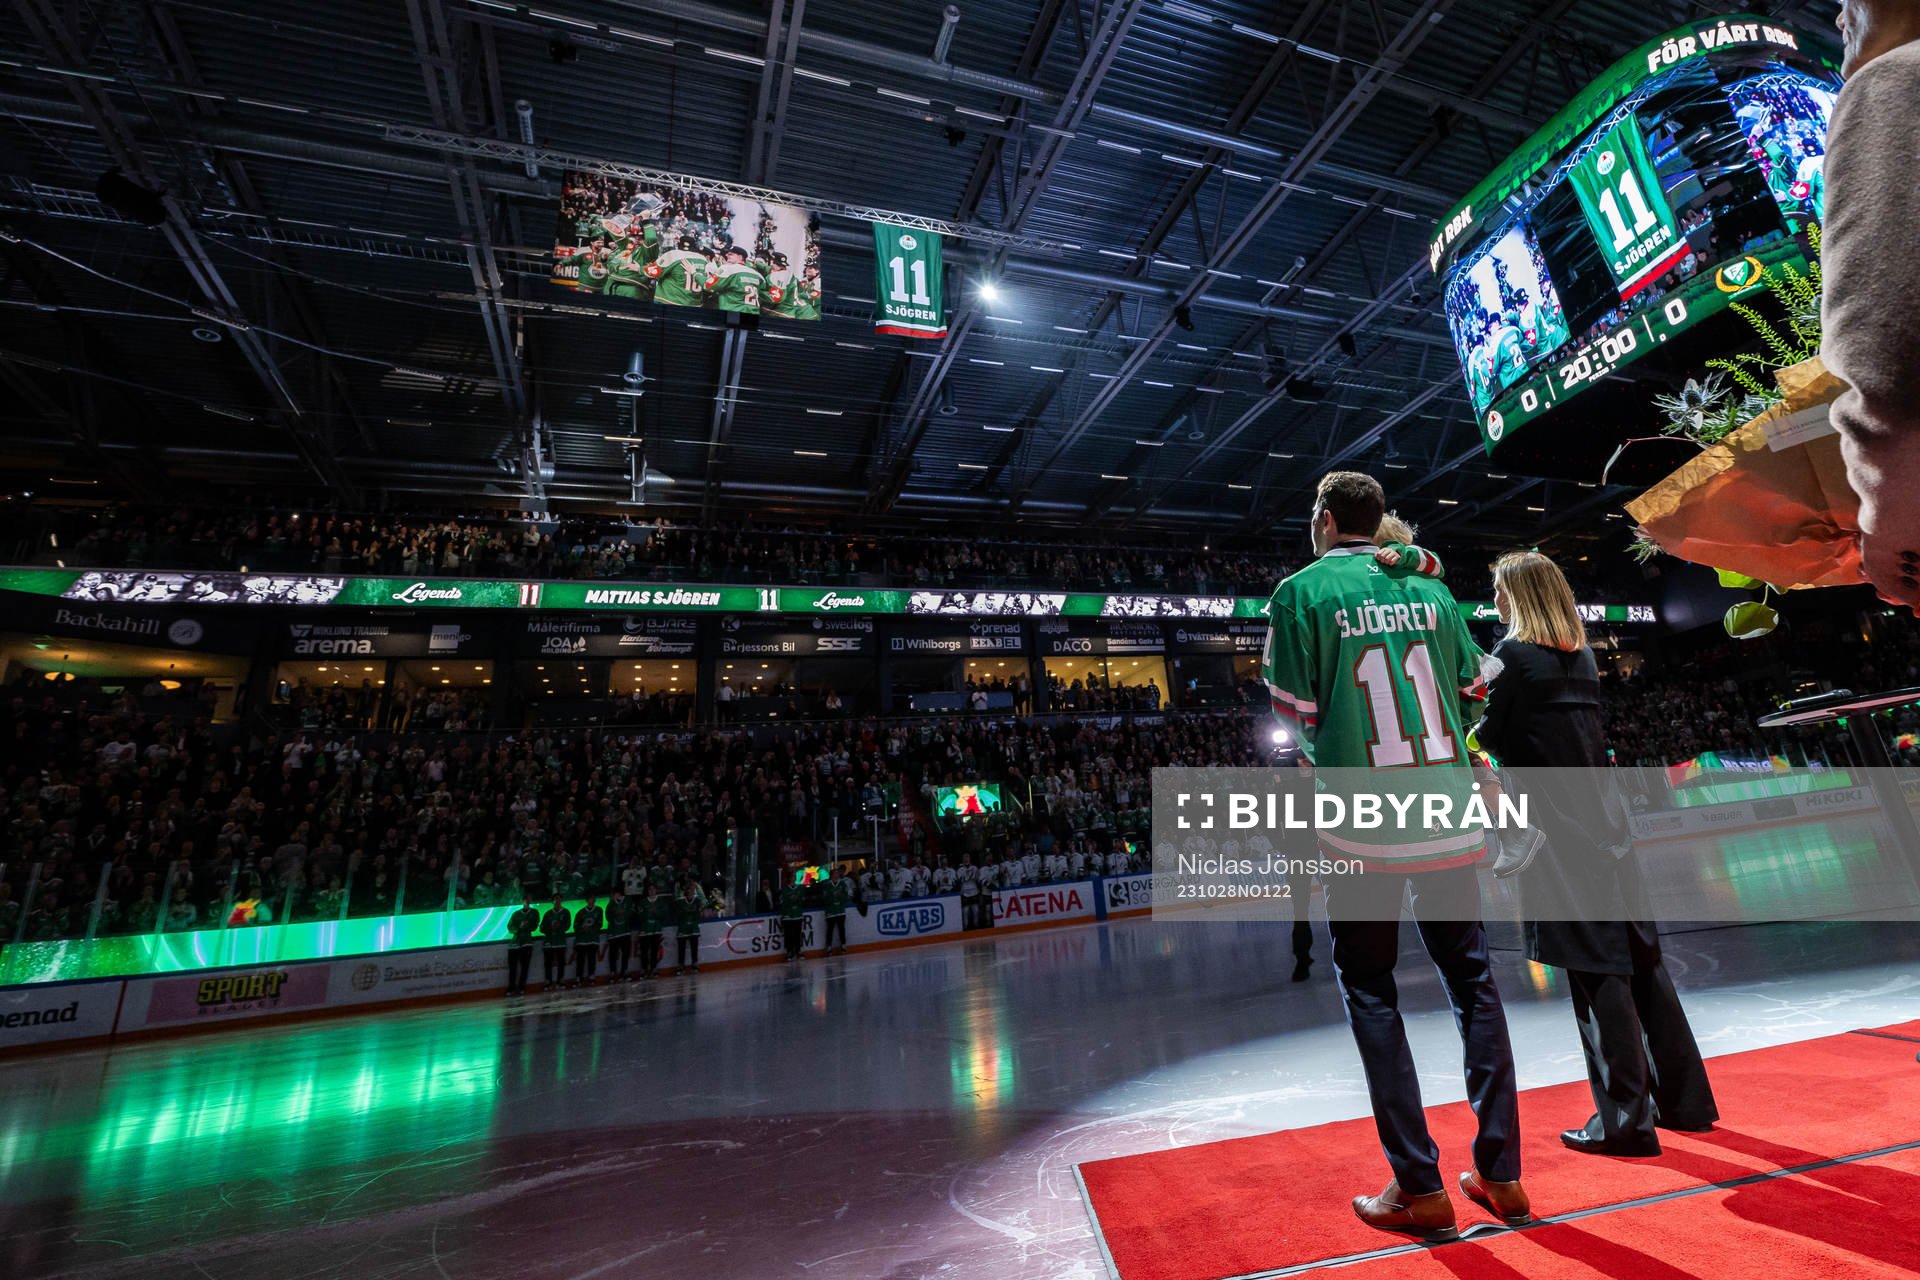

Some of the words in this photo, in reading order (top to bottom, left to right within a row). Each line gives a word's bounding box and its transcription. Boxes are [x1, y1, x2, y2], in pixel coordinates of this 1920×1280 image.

[1647, 37, 1697, 73] FÖR
[1699, 20, 1758, 49] VÅRT
[1598, 168, 1657, 253] 11
[1445, 204, 1473, 244] RBK
[1614, 224, 1672, 275] SJÖGREN
[889, 256, 931, 306] 11
[885, 303, 937, 321] SJÖGREN
[1520, 388, 1539, 413] 0
[1559, 328, 1637, 390] 20:00
[1665, 298, 1688, 326] 0
[392, 582, 462, 604] Legends
[520, 584, 541, 607] 11
[584, 589, 650, 604] MATTIAS
[652, 588, 721, 606] SJÖGREN
[760, 588, 778, 611] 11
[812, 591, 865, 611] Legends
[54, 608, 160, 636] Backahill
[527, 621, 601, 634] Målerifirma
[980, 622, 1021, 635] prenad
[1334, 598, 1437, 638] SJÖGREN
[312, 625, 352, 636] WIKLUND
[353, 625, 390, 636] TRADING
[541, 636, 573, 648] JOA
[782, 641, 796, 653] Bil
[815, 637, 862, 651] SSE
[906, 639, 961, 652] Wihlborgs
[1053, 640, 1092, 653] DACO
[1352, 640, 1459, 768] 11
[769, 914, 813, 935] INR
[882, 907, 941, 930] KAABS
[752, 931, 814, 952] SYSM
[197, 972, 288, 1006] SPORT
